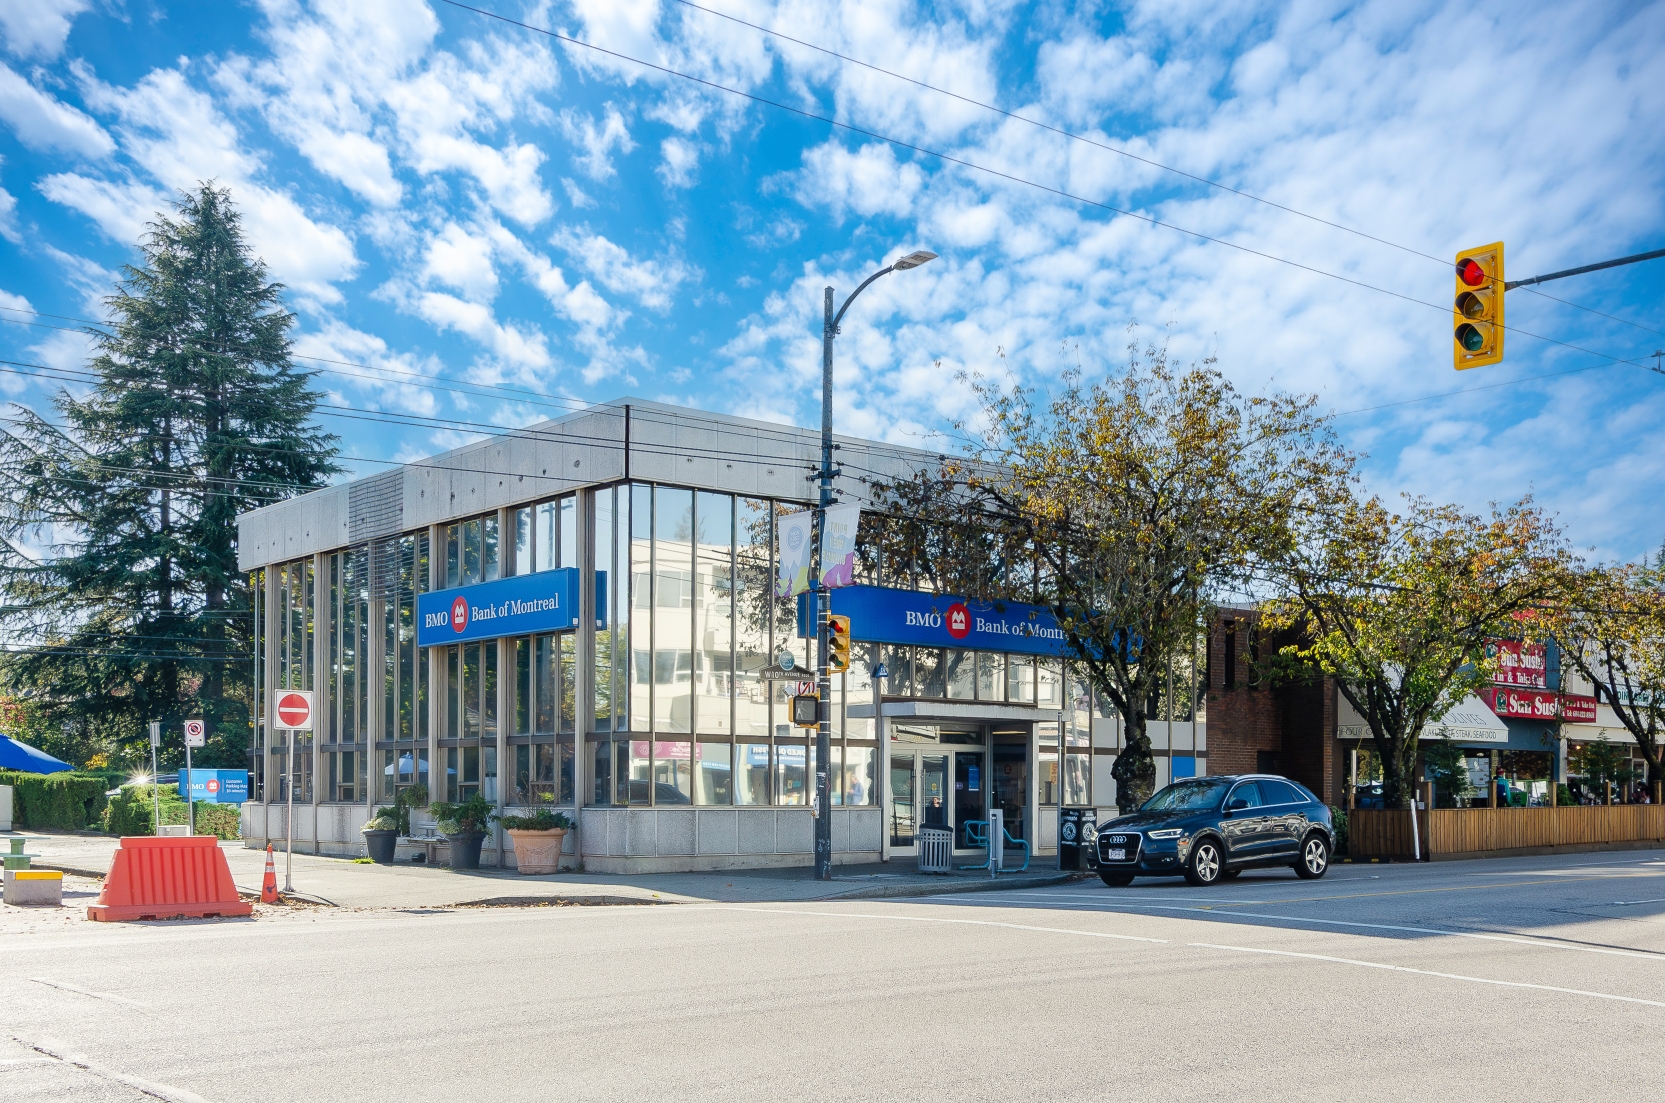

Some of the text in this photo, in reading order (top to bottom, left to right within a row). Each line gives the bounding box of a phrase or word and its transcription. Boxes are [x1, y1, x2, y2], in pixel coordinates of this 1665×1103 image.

[425, 592, 559, 628] BMO Bank of Montreal
[905, 610, 941, 628] BMO
[975, 617, 1010, 635] Bank
[1011, 621, 1026, 636] of
[1507, 671, 1514, 682] &
[1509, 694, 1532, 714] Sun
[1473, 730, 1497, 739] SEAFOOD
